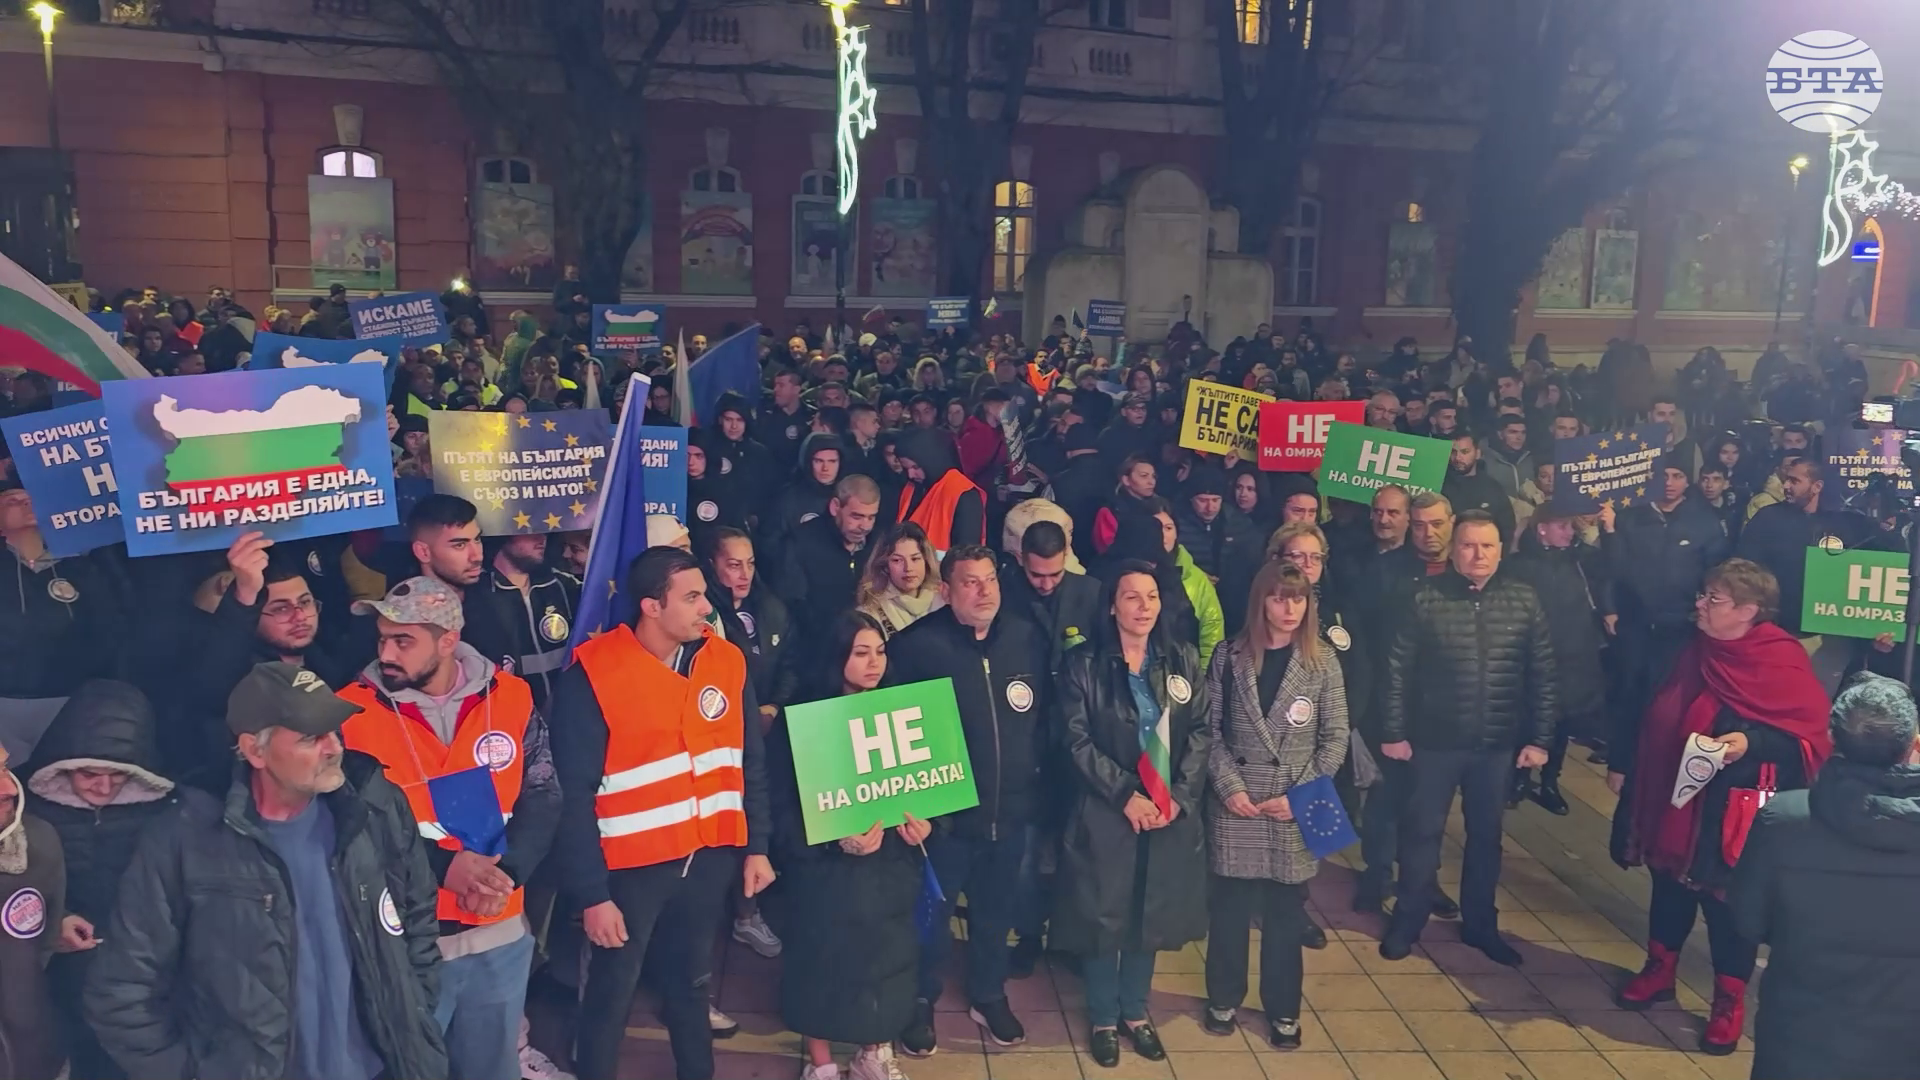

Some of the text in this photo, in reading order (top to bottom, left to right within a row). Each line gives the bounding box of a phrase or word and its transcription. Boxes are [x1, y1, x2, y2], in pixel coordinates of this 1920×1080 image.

[358, 299, 435, 325] ИСКАМЕ
[1196, 397, 1230, 429] НЕ
[20, 420, 96, 447] ВСИЧКИ
[1288, 414, 1336, 444] НЕ
[40, 444, 81, 467] НА
[443, 446, 605, 464] ПЪТЯТ НА БЪЛГАРИЯ
[1264, 447, 1326, 458] НА ОМРА
[1357, 440, 1415, 480] НЕ
[1561, 448, 1661, 473] ПЪТЯТ НА БЪЛГАРИЯ
[1829, 455, 1869, 465] ПЪТЯТ
[1871, 456, 1888, 465] НА
[460, 464, 592, 482] Е ЕВРОПЕЙСКИЯТ
[1328, 469, 1348, 484] НА
[1571, 461, 1653, 483] Е ЕВРОПЕЙСКИЯТ
[1840, 467, 1848, 476] Е
[138, 468, 377, 509] БЪЛГАРИЯ Е ЕДНА,
[473, 482, 584, 500] СЪЮЗ И НАТО!
[1579, 482, 1611, 494] СЪЮЗ
[1612, 480, 1619, 489] И
[51, 502, 122, 529] ВТОРА
[136, 489, 385, 534] НЕ НИ РАЗДЕЛЯЙТЕ!
[1847, 564, 1910, 605] НЕ
[1814, 602, 1905, 623] НА ОМРАЗ
[848, 706, 932, 775] НЕ
[817, 762, 965, 812] НА ОМРАЗАТА!
